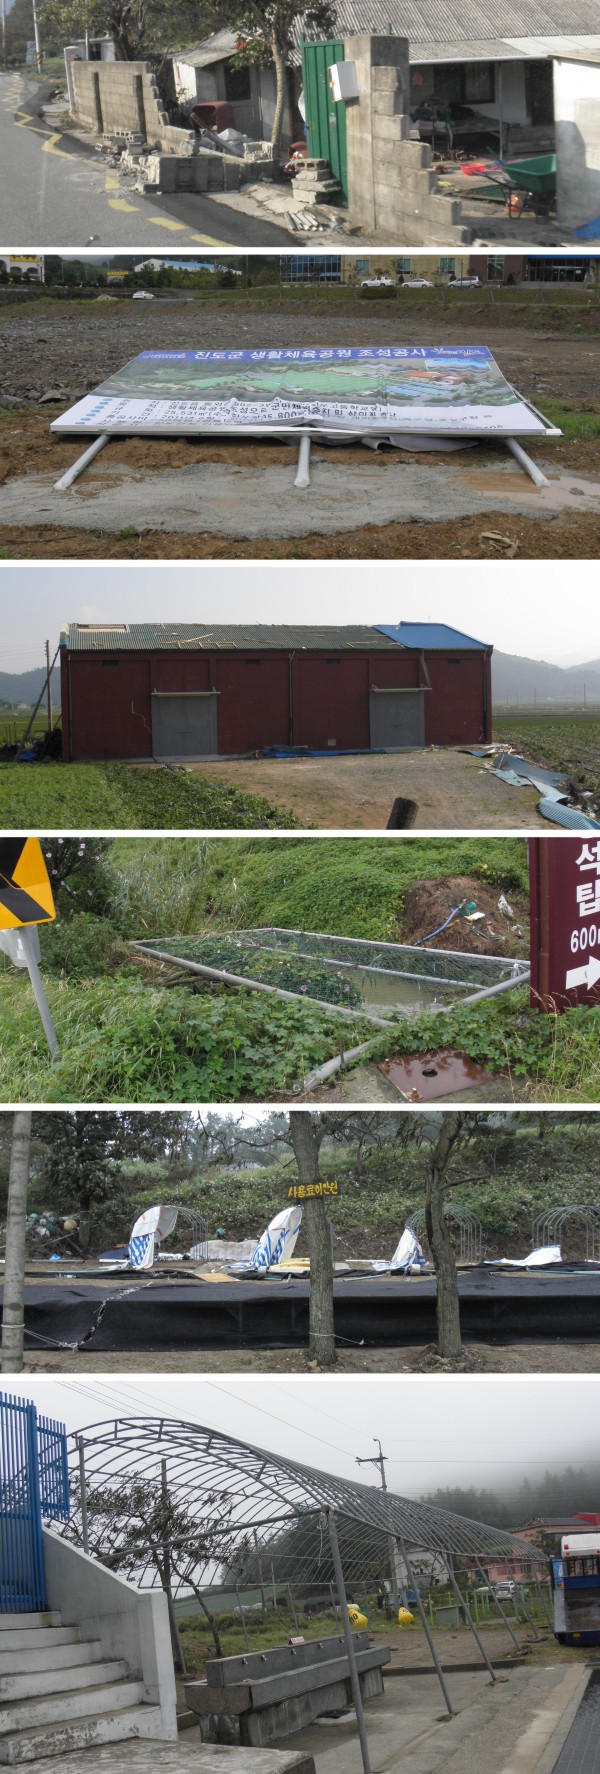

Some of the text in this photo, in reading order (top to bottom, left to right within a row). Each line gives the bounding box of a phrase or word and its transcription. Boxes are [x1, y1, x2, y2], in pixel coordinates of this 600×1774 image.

[194, 351, 243, 360] 진도군
[250, 349, 352, 360] 생활체육공원
[357, 348, 427, 357] 조성공사
[575, 837, 600, 917] 석탑
[570, 924, 600, 953] 600
